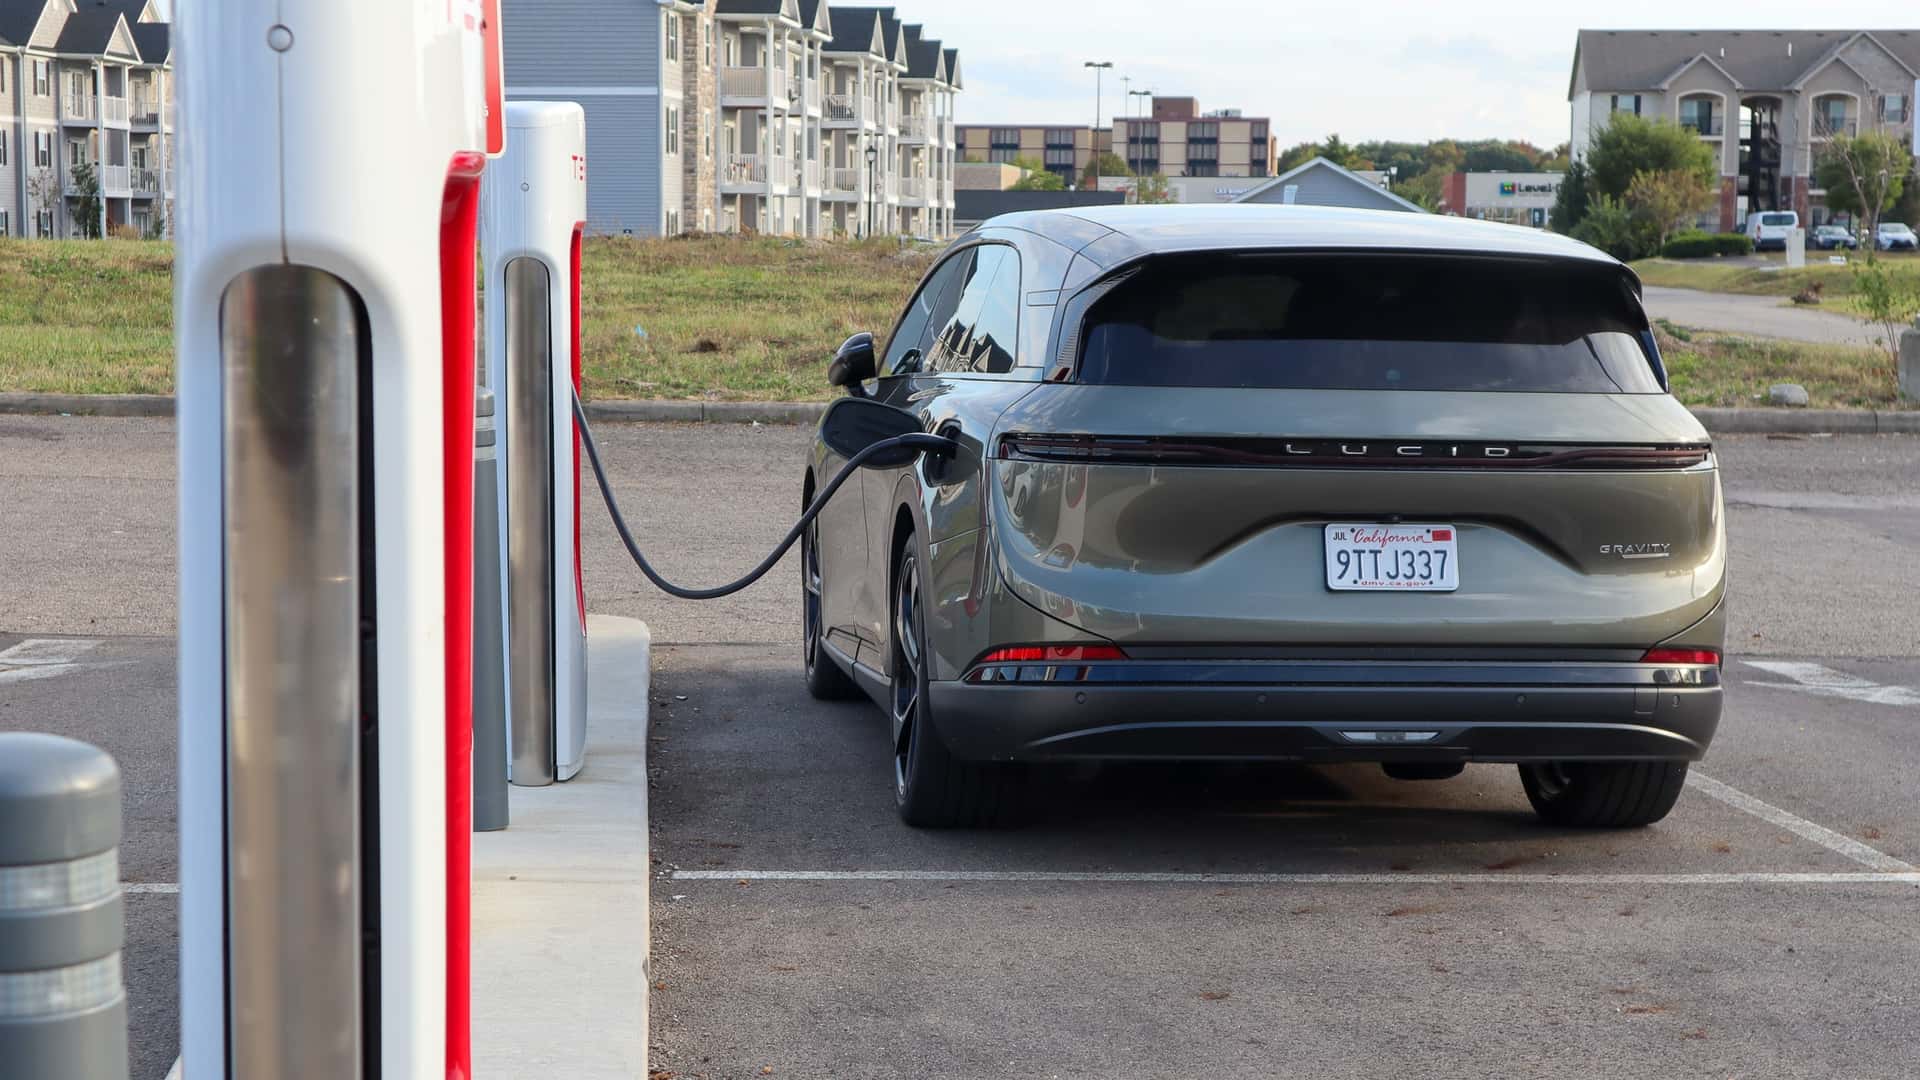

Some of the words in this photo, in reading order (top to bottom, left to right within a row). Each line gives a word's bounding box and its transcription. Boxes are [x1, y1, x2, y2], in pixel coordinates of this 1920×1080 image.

[1286, 444, 1510, 457] LUCID
[1333, 531, 1348, 541] JUL
[1353, 528, 1432, 548] California
[1600, 543, 1671, 554] GRAVITY
[1336, 549, 1448, 580] 9TTJ337
